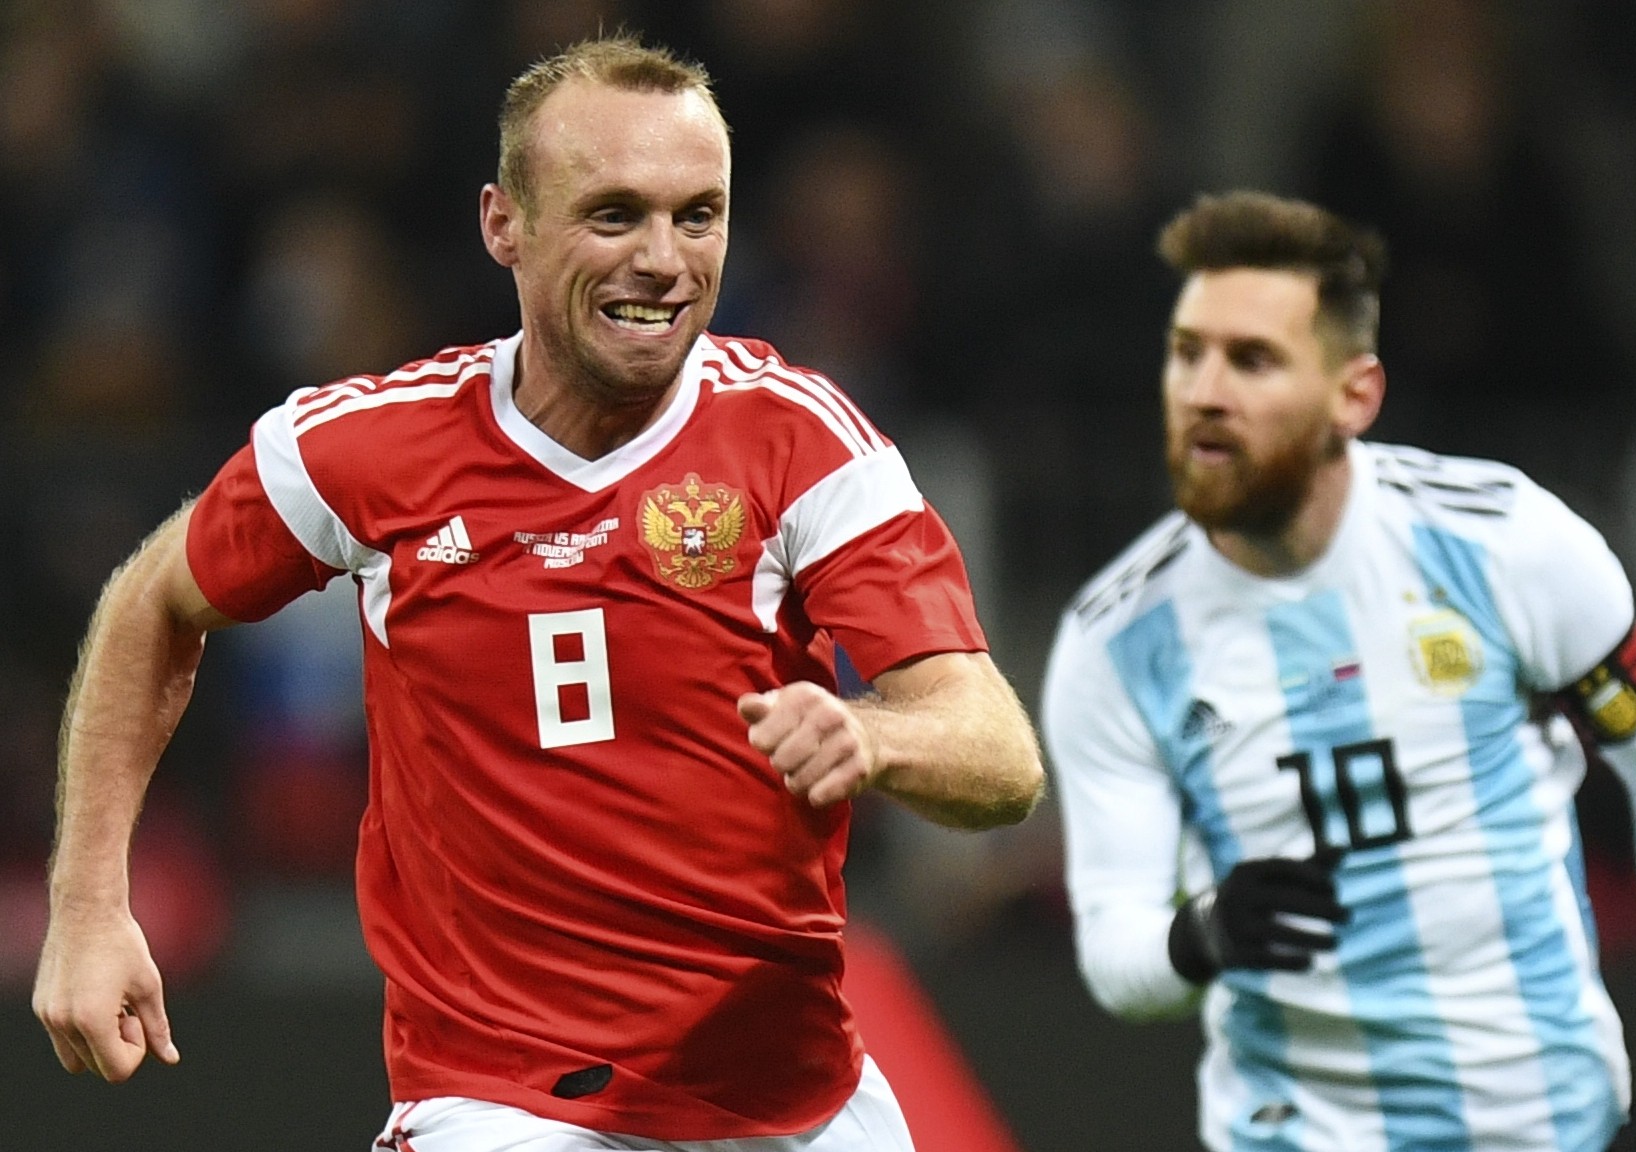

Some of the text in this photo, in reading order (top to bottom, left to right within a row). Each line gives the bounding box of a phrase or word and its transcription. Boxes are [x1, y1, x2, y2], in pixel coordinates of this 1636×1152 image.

[417, 545, 480, 565] adidas
[527, 607, 616, 749] 8
[1276, 737, 1415, 858] 10
